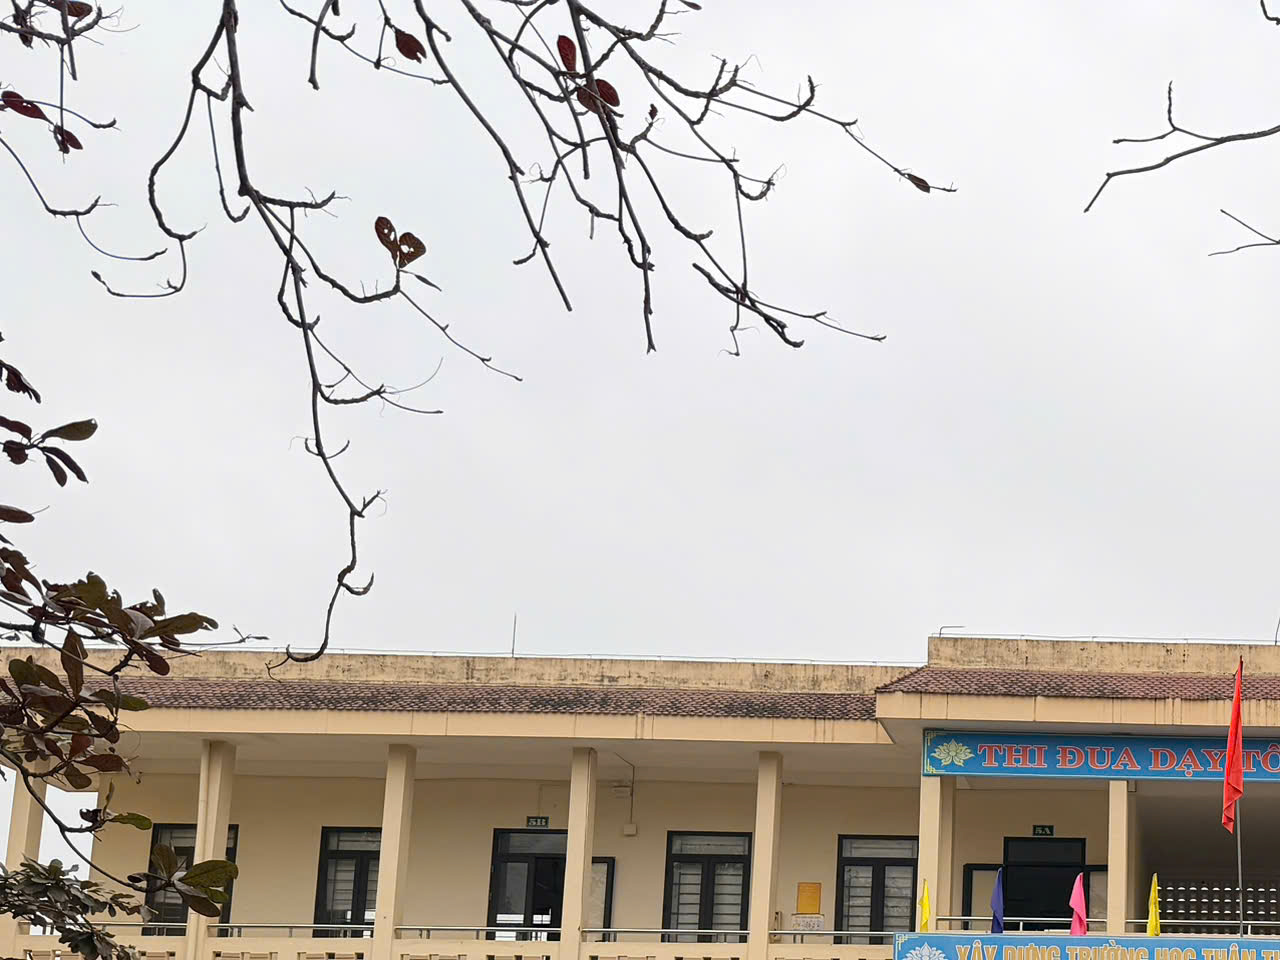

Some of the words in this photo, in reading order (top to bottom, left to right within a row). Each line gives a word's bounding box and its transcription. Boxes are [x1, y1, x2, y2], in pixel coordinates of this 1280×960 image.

[978, 744, 1048, 768] THI
[1056, 745, 1141, 771] ĐUA
[1149, 747, 1227, 777] DẠY
